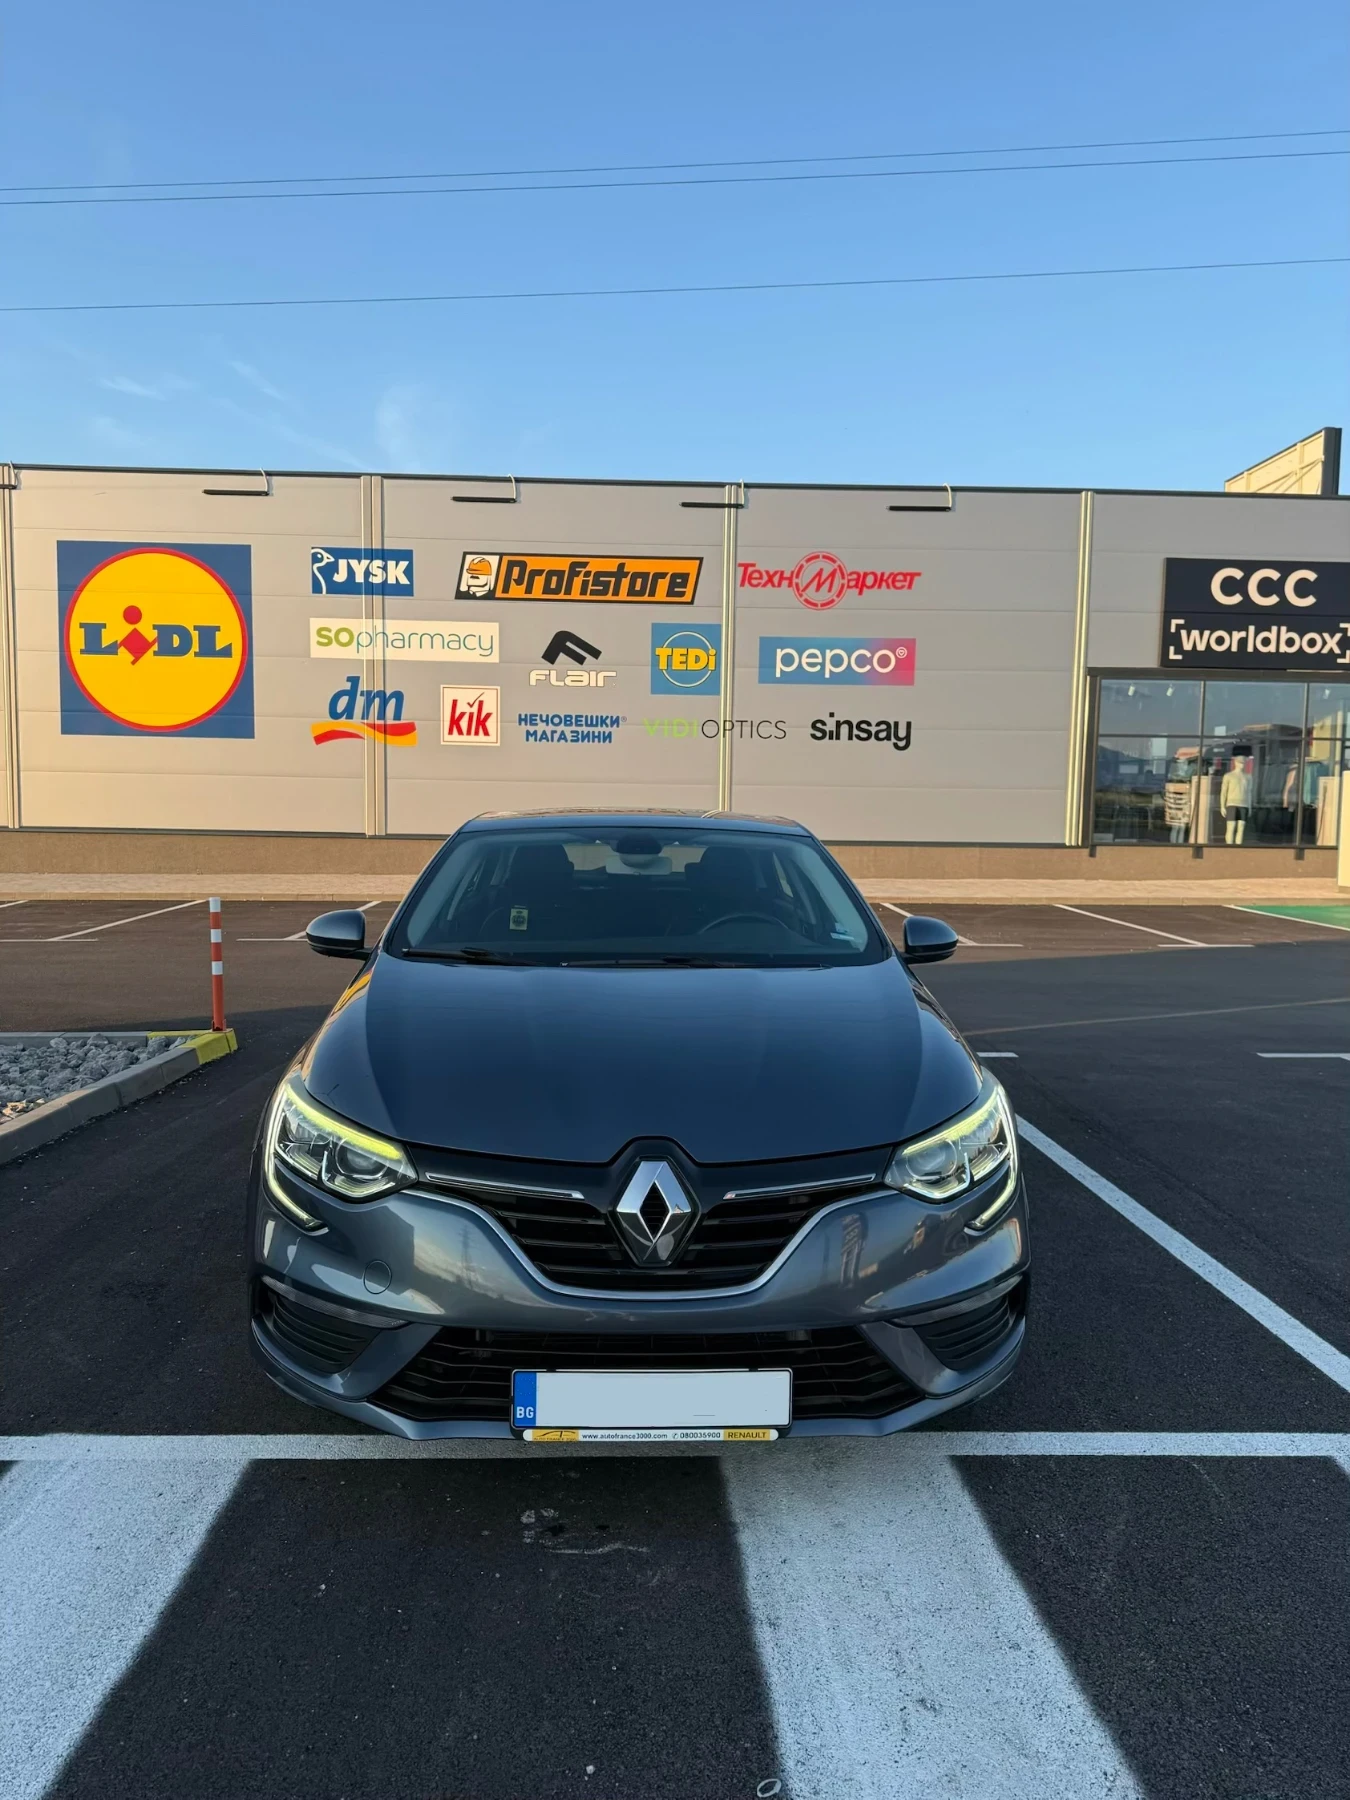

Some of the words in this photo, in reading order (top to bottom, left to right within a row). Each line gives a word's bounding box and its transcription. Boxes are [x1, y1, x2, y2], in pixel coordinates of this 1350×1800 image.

[333, 559, 411, 585] JYSK
[501, 559, 691, 598] Profistore
[1210, 567, 1319, 607] CCC
[655, 647, 717, 671] TEDi
[775, 648, 896, 679] pepco
[328, 675, 405, 722] dm
[525, 730, 613, 744] МАГАЗИНИ
[809, 712, 913, 751] sinsay
[516, 1406, 535, 1419] BG
[727, 1431, 767, 1440] RENAULT
